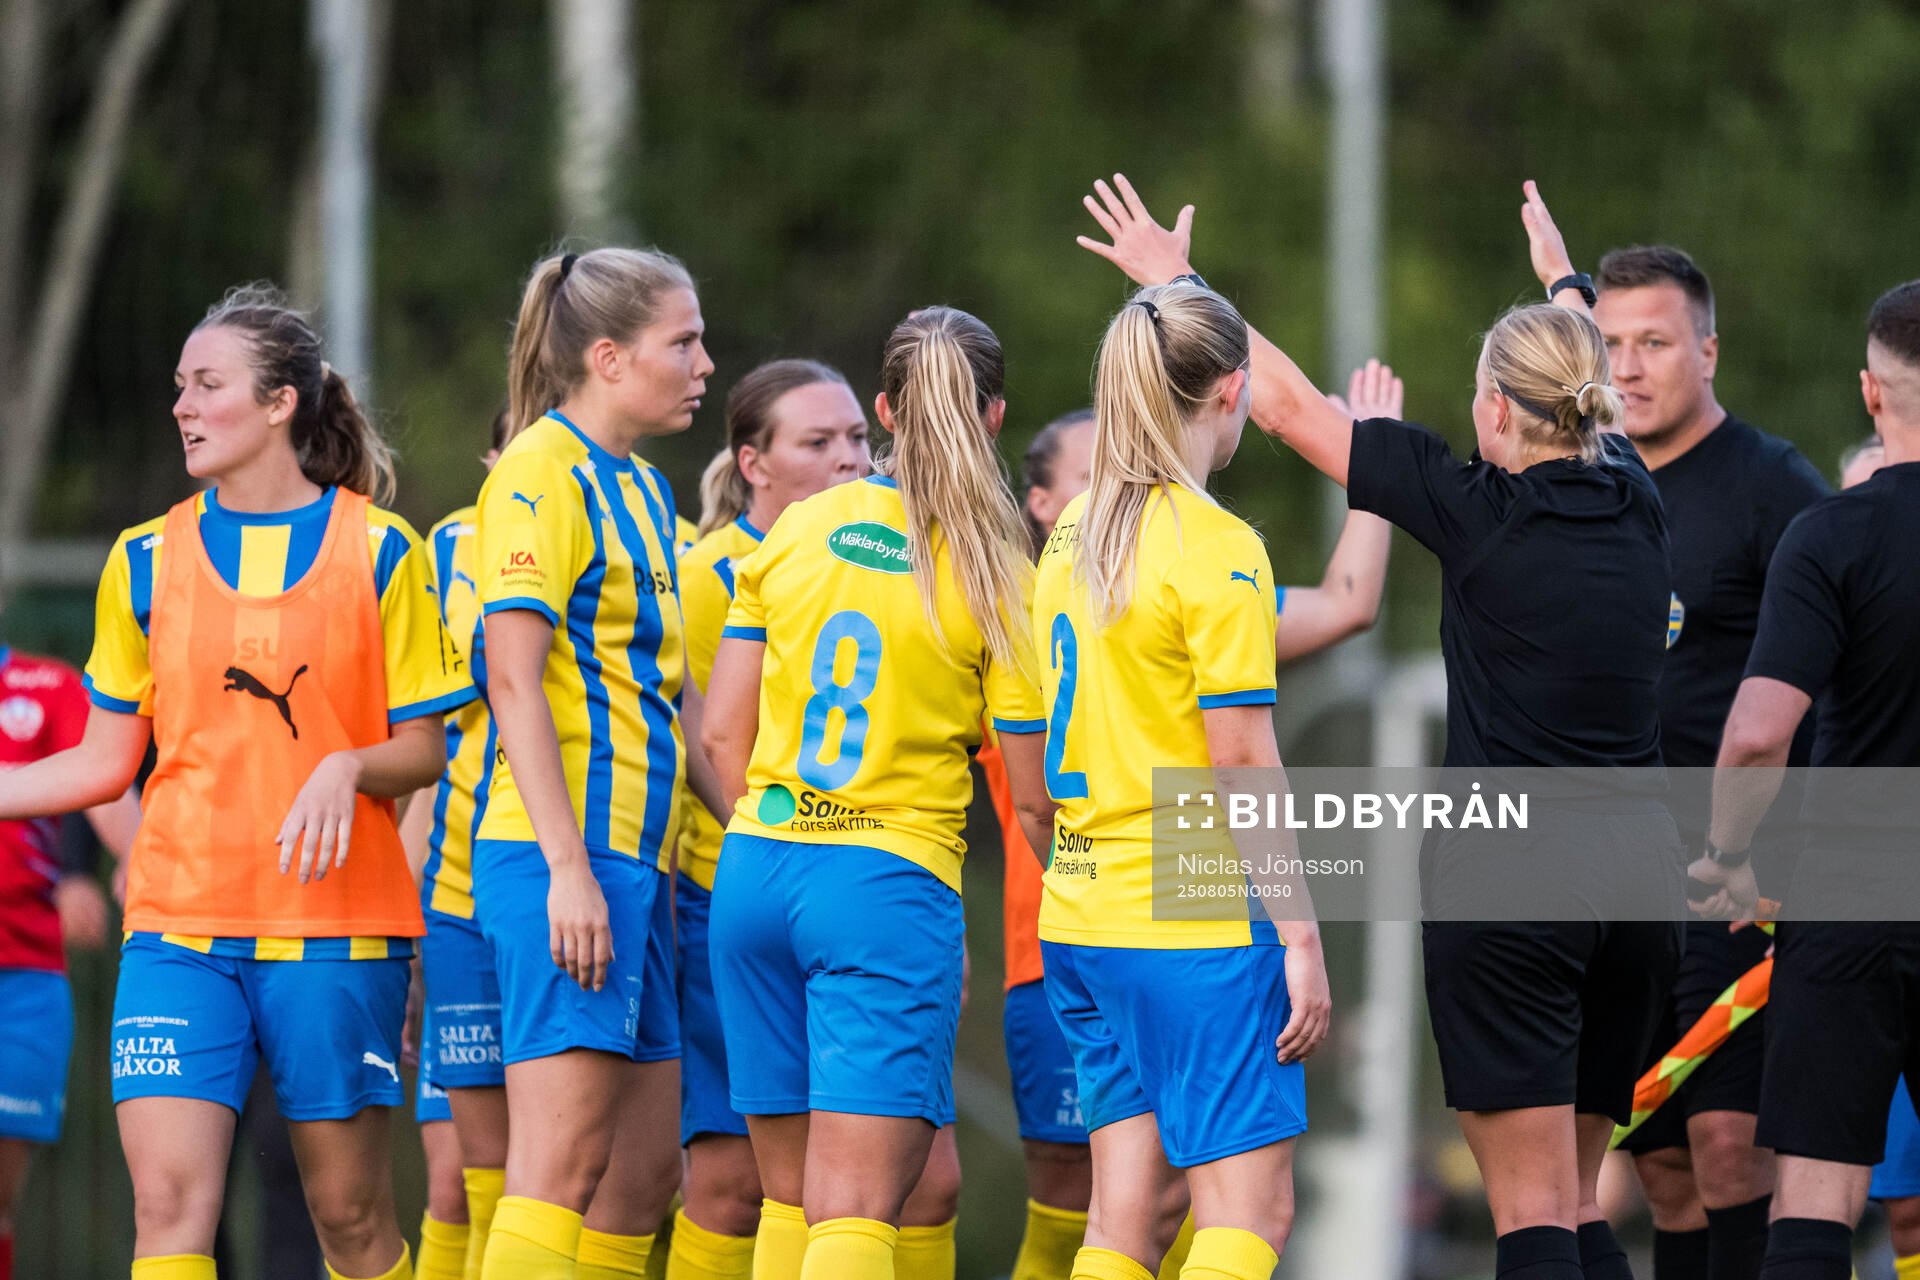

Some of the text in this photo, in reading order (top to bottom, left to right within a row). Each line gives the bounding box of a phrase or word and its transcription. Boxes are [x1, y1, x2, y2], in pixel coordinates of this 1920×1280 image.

[510, 551, 536, 566] ICA
[797, 610, 882, 791] 8
[1044, 613, 1089, 799] 2
[1054, 856, 1097, 879] Försäkring
[439, 1024, 495, 1044] SALTA
[116, 1037, 176, 1057] SALTA
